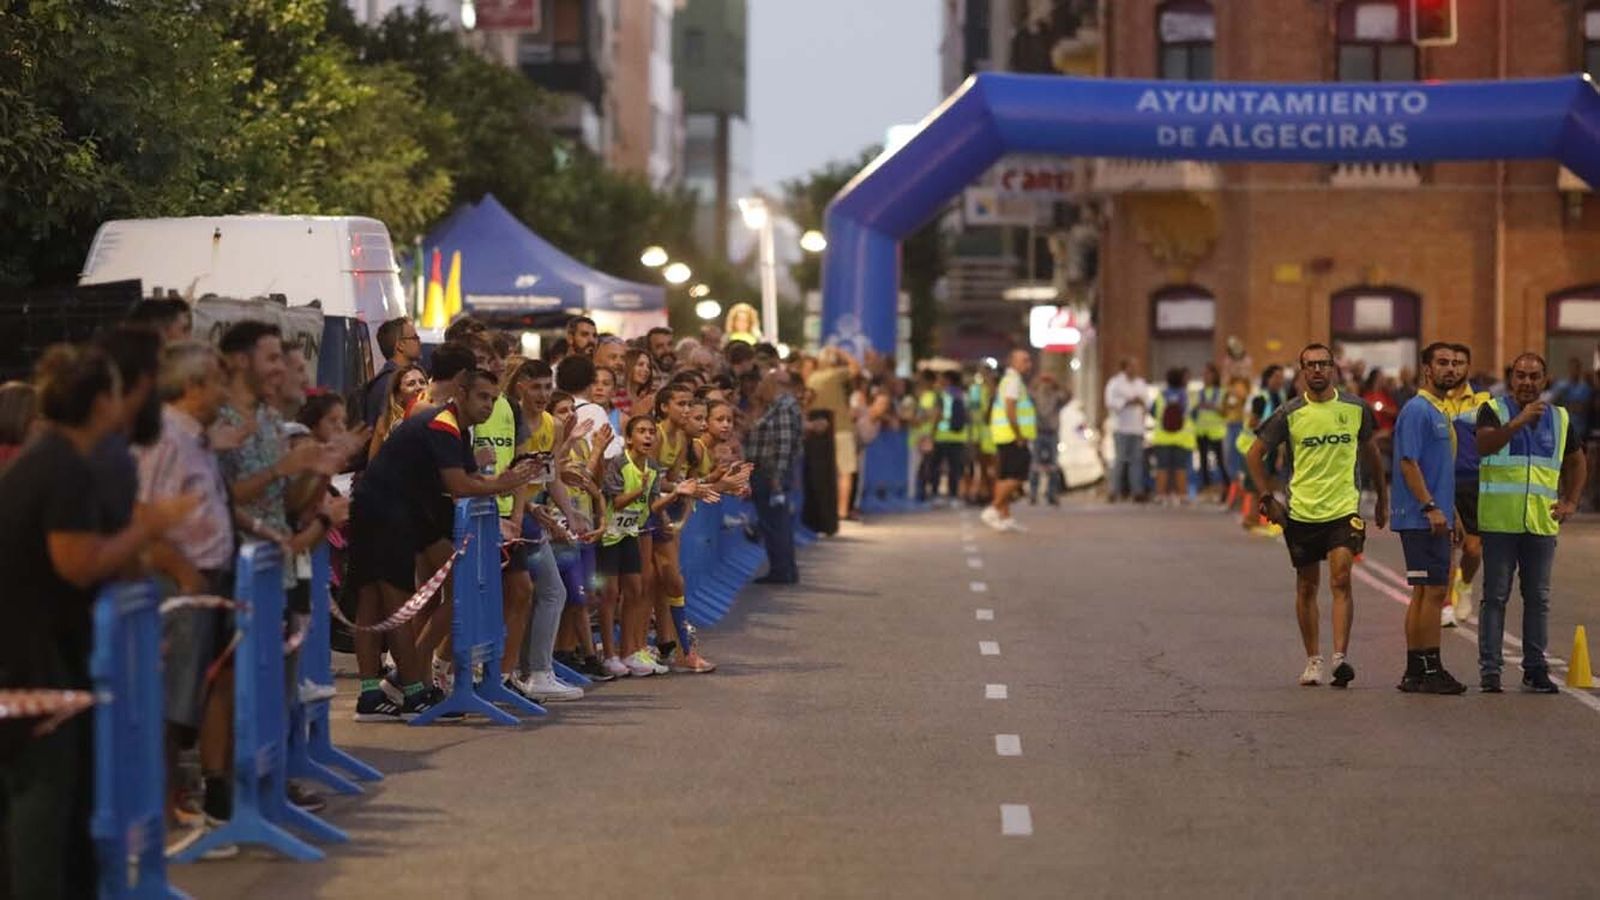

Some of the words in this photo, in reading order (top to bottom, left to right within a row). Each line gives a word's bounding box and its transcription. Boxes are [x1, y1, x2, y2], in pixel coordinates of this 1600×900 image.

[1136, 90, 1428, 115] AYUNTAMIENTO
[1156, 125, 1197, 147] DE
[1206, 122, 1409, 149] ALGECIRAS
[1301, 433, 1352, 448] EVOS
